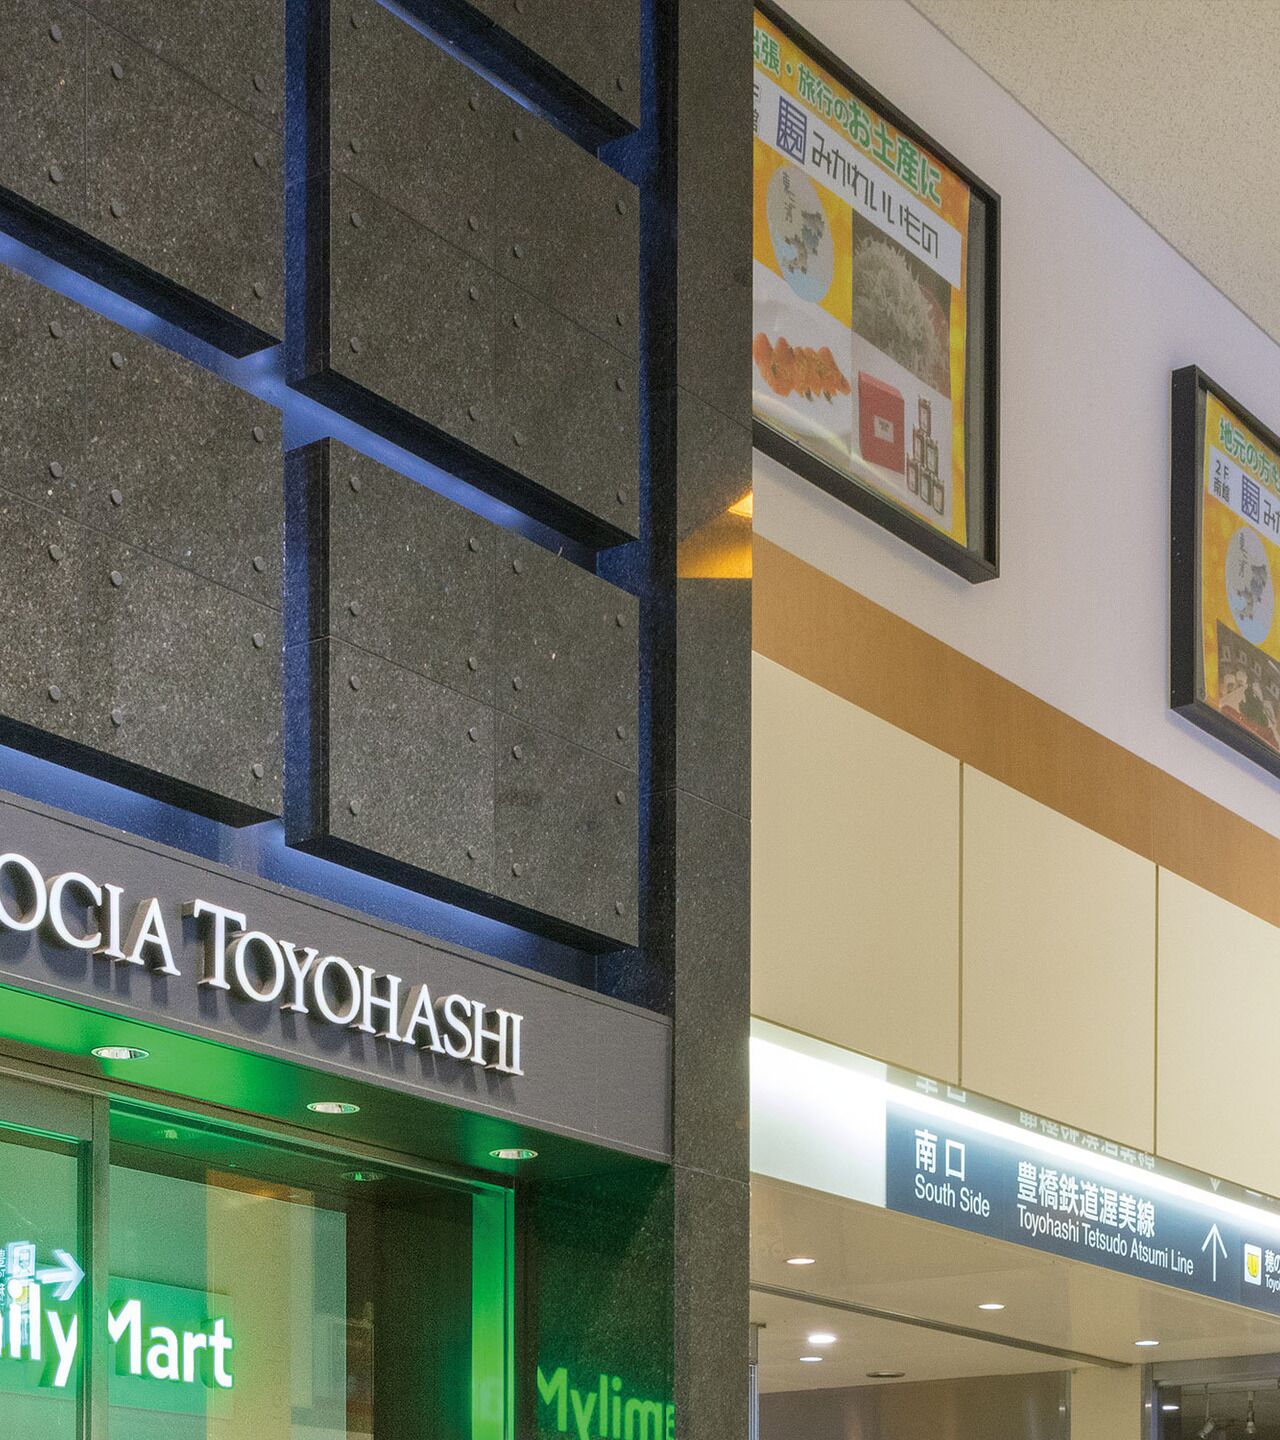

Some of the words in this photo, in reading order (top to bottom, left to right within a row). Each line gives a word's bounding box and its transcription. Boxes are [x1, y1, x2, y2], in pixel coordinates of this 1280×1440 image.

[811, 130, 940, 260] みかわいいもの
[192, 898, 525, 1077] TOYOHASHI
[914, 1128, 967, 1182] 南口
[1017, 1160, 1156, 1239] 豊橋鉄道渥美線
[914, 1173, 957, 1209] South
[959, 1186, 991, 1218] Side
[1017, 1203, 1081, 1244] Toyohashi
[1081, 1223, 1128, 1257] Tetsudo
[1130, 1240, 1169, 1269] Atsumi
[1170, 1250, 1195, 1276] Line
